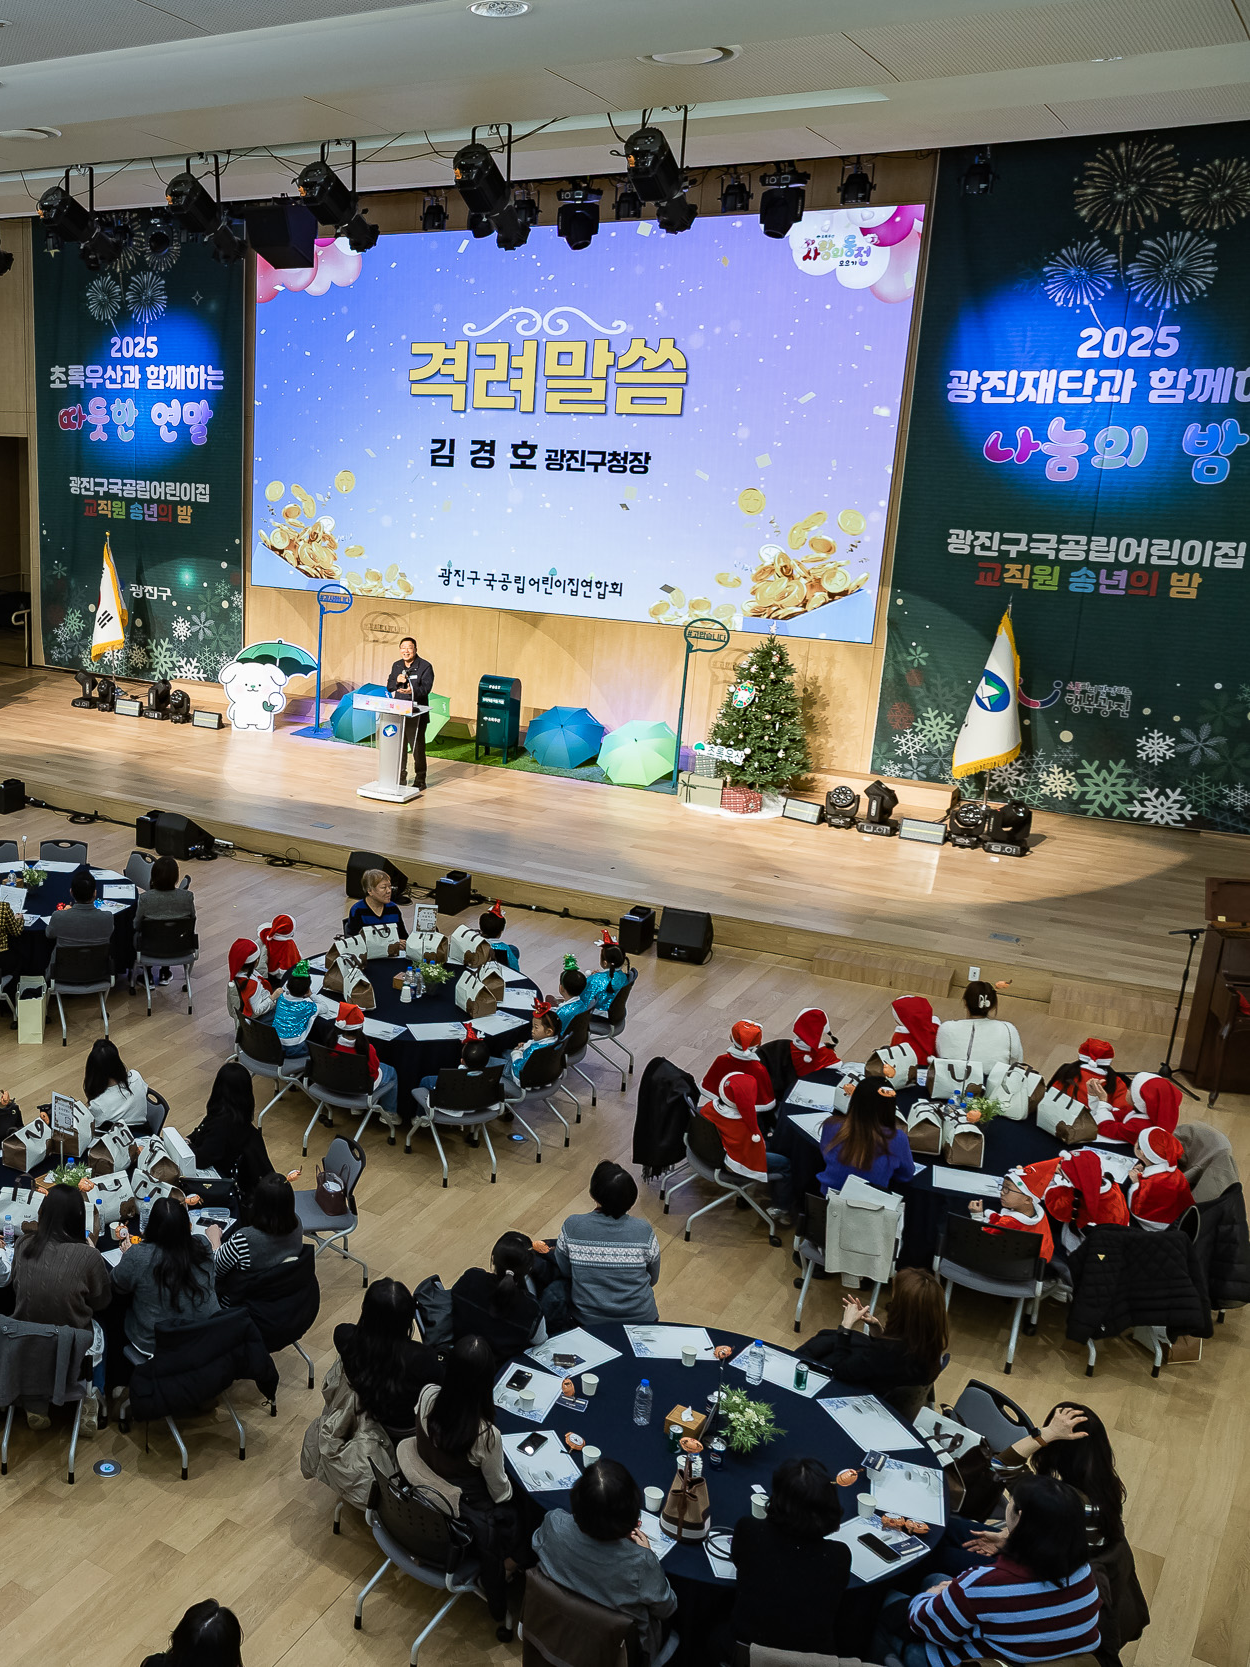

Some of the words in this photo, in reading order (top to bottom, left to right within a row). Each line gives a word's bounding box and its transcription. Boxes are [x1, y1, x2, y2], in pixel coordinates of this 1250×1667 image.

[802, 239, 844, 261] 사랑의
[842, 234, 871, 266] 동전
[110, 336, 158, 358] 2025
[1076, 326, 1181, 358] 2025
[50, 365, 141, 389] 초록우산과
[146, 365, 224, 390] 함께하는
[409, 338, 688, 415] 격려말씀
[946, 369, 1138, 404] 광진재단과
[150, 399, 213, 446] 연말
[430, 438, 456, 468] 김
[470, 440, 496, 469] 경
[510, 440, 538, 470] 호
[544, 448, 651, 475] 광진구청장
[983, 417, 1148, 482] 나눔의
[1182, 418, 1249, 484] 밤
[69, 476, 210, 503] 광진구국공립어린이집
[83, 499, 126, 519] 교직원
[129, 502, 172, 522] 송년의
[177, 505, 193, 524] 밤
[947, 529, 1247, 569] 광진구국공립어린이집
[129, 583, 172, 601] 광진구
[974, 562, 1060, 591] 교직원
[1068, 566, 1159, 597] 송년의
[1169, 572, 1203, 599] 밤
